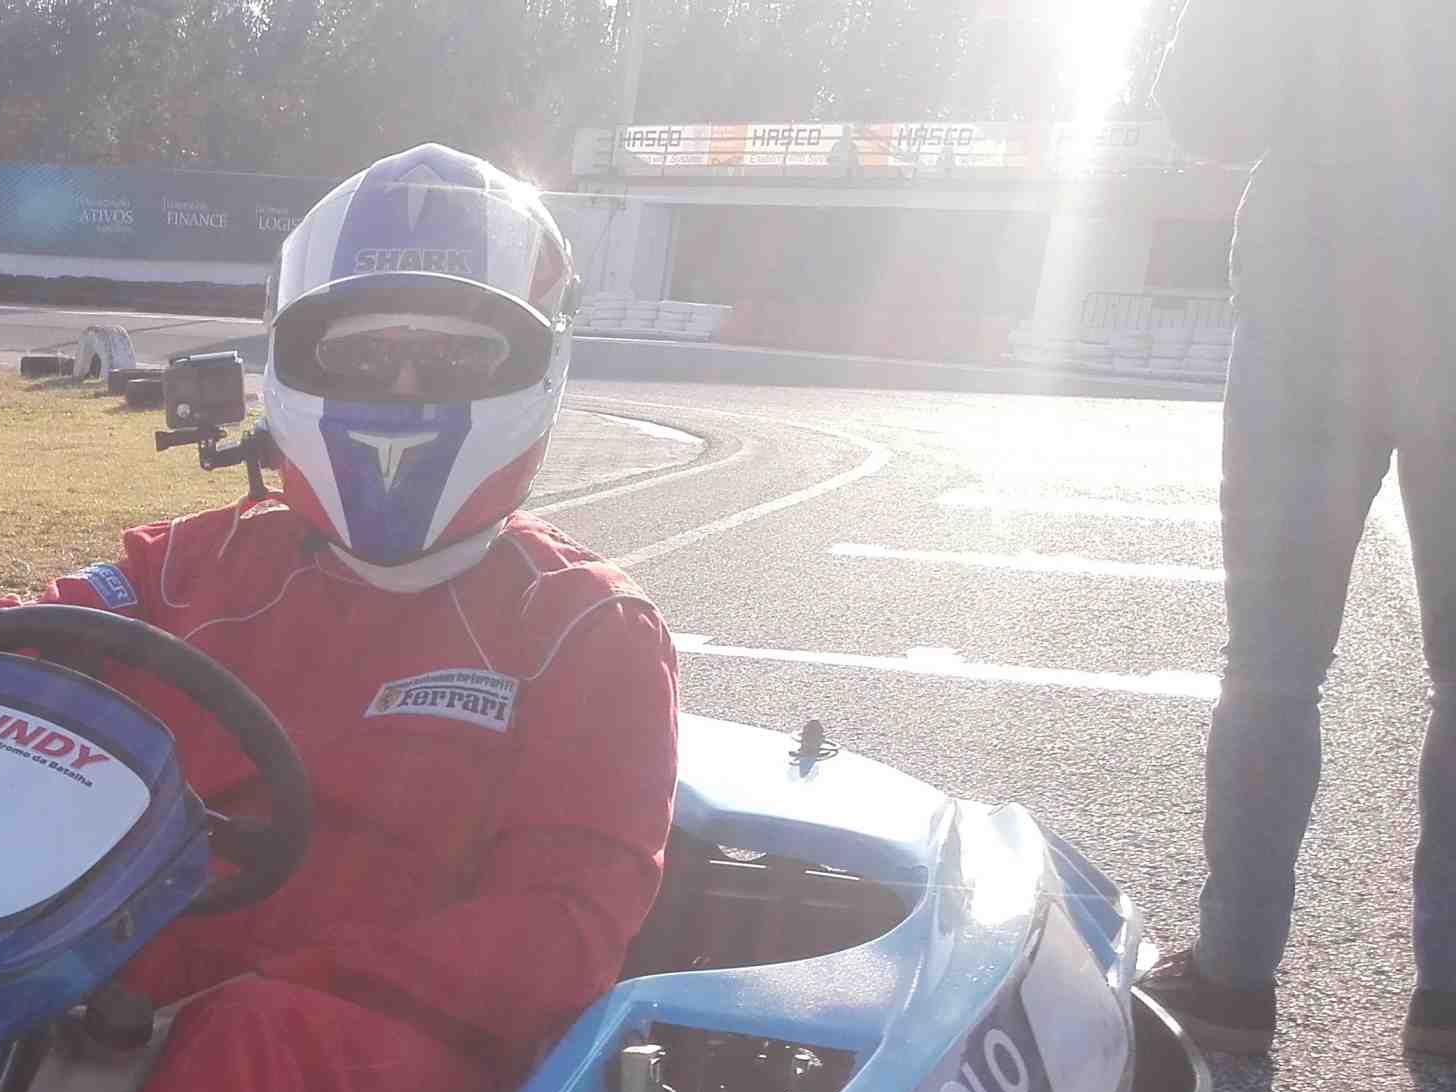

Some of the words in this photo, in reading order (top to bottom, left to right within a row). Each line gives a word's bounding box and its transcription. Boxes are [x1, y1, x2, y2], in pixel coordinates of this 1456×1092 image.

[752, 128, 822, 147] HASCO
[896, 127, 975, 147] HASCO
[167, 210, 226, 229] FINANCE
[353, 248, 473, 274] SHARK
[47, 760, 94, 788] Batalha
